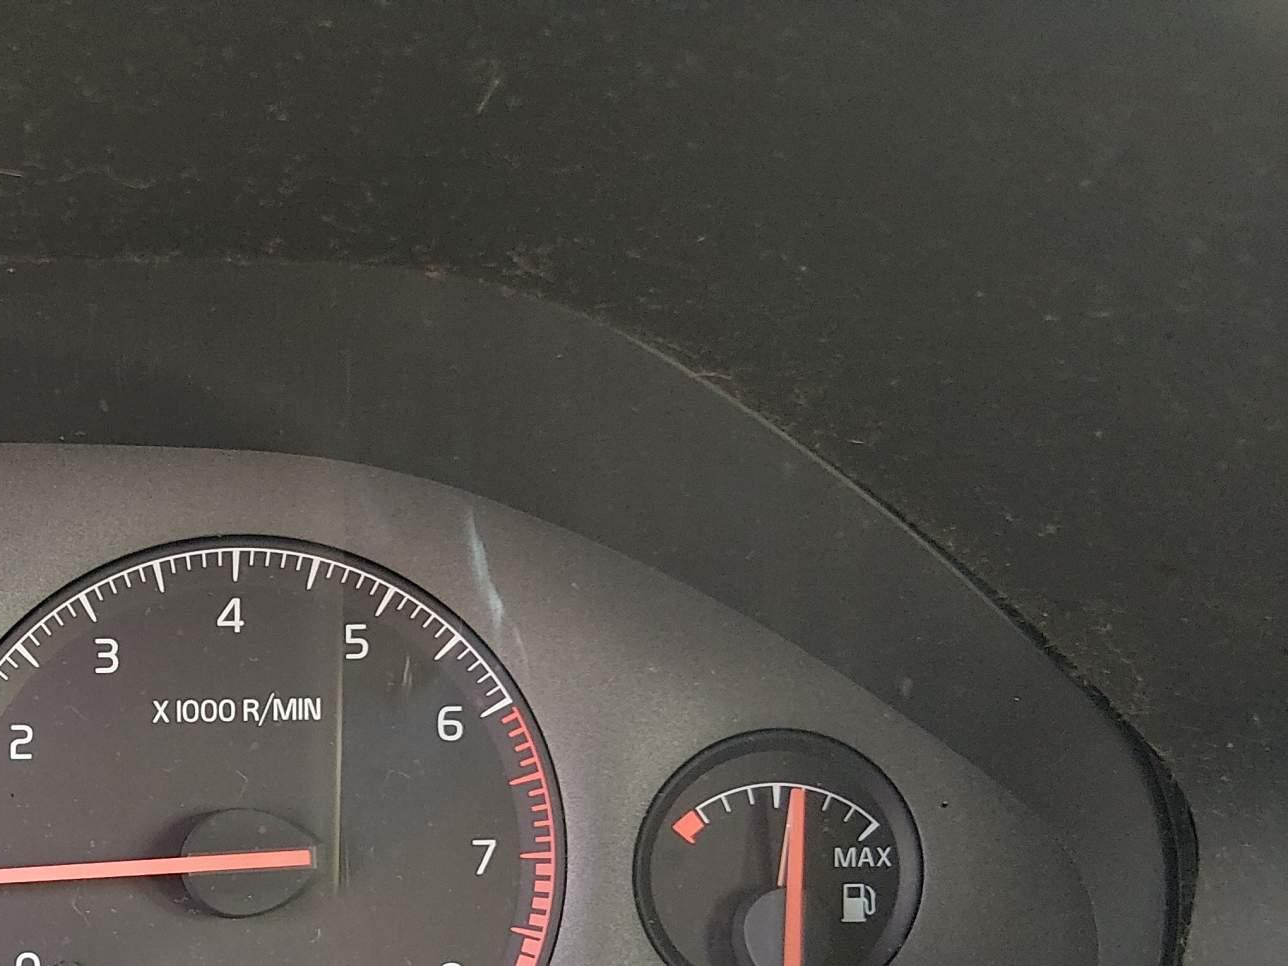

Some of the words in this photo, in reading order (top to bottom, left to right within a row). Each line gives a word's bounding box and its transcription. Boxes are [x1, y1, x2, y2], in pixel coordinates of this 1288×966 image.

[216, 598, 244, 632] 4
[95, 639, 119, 673] 3
[345, 624, 369, 658] 5
[153, 700, 172, 722] X
[176, 699, 236, 722] 1000
[243, 694, 321, 726] R/MIN
[437, 706, 463, 741] 6
[10, 725, 33, 760] 2
[472, 839, 496, 875] 7
[834, 847, 891, 867] MAX
